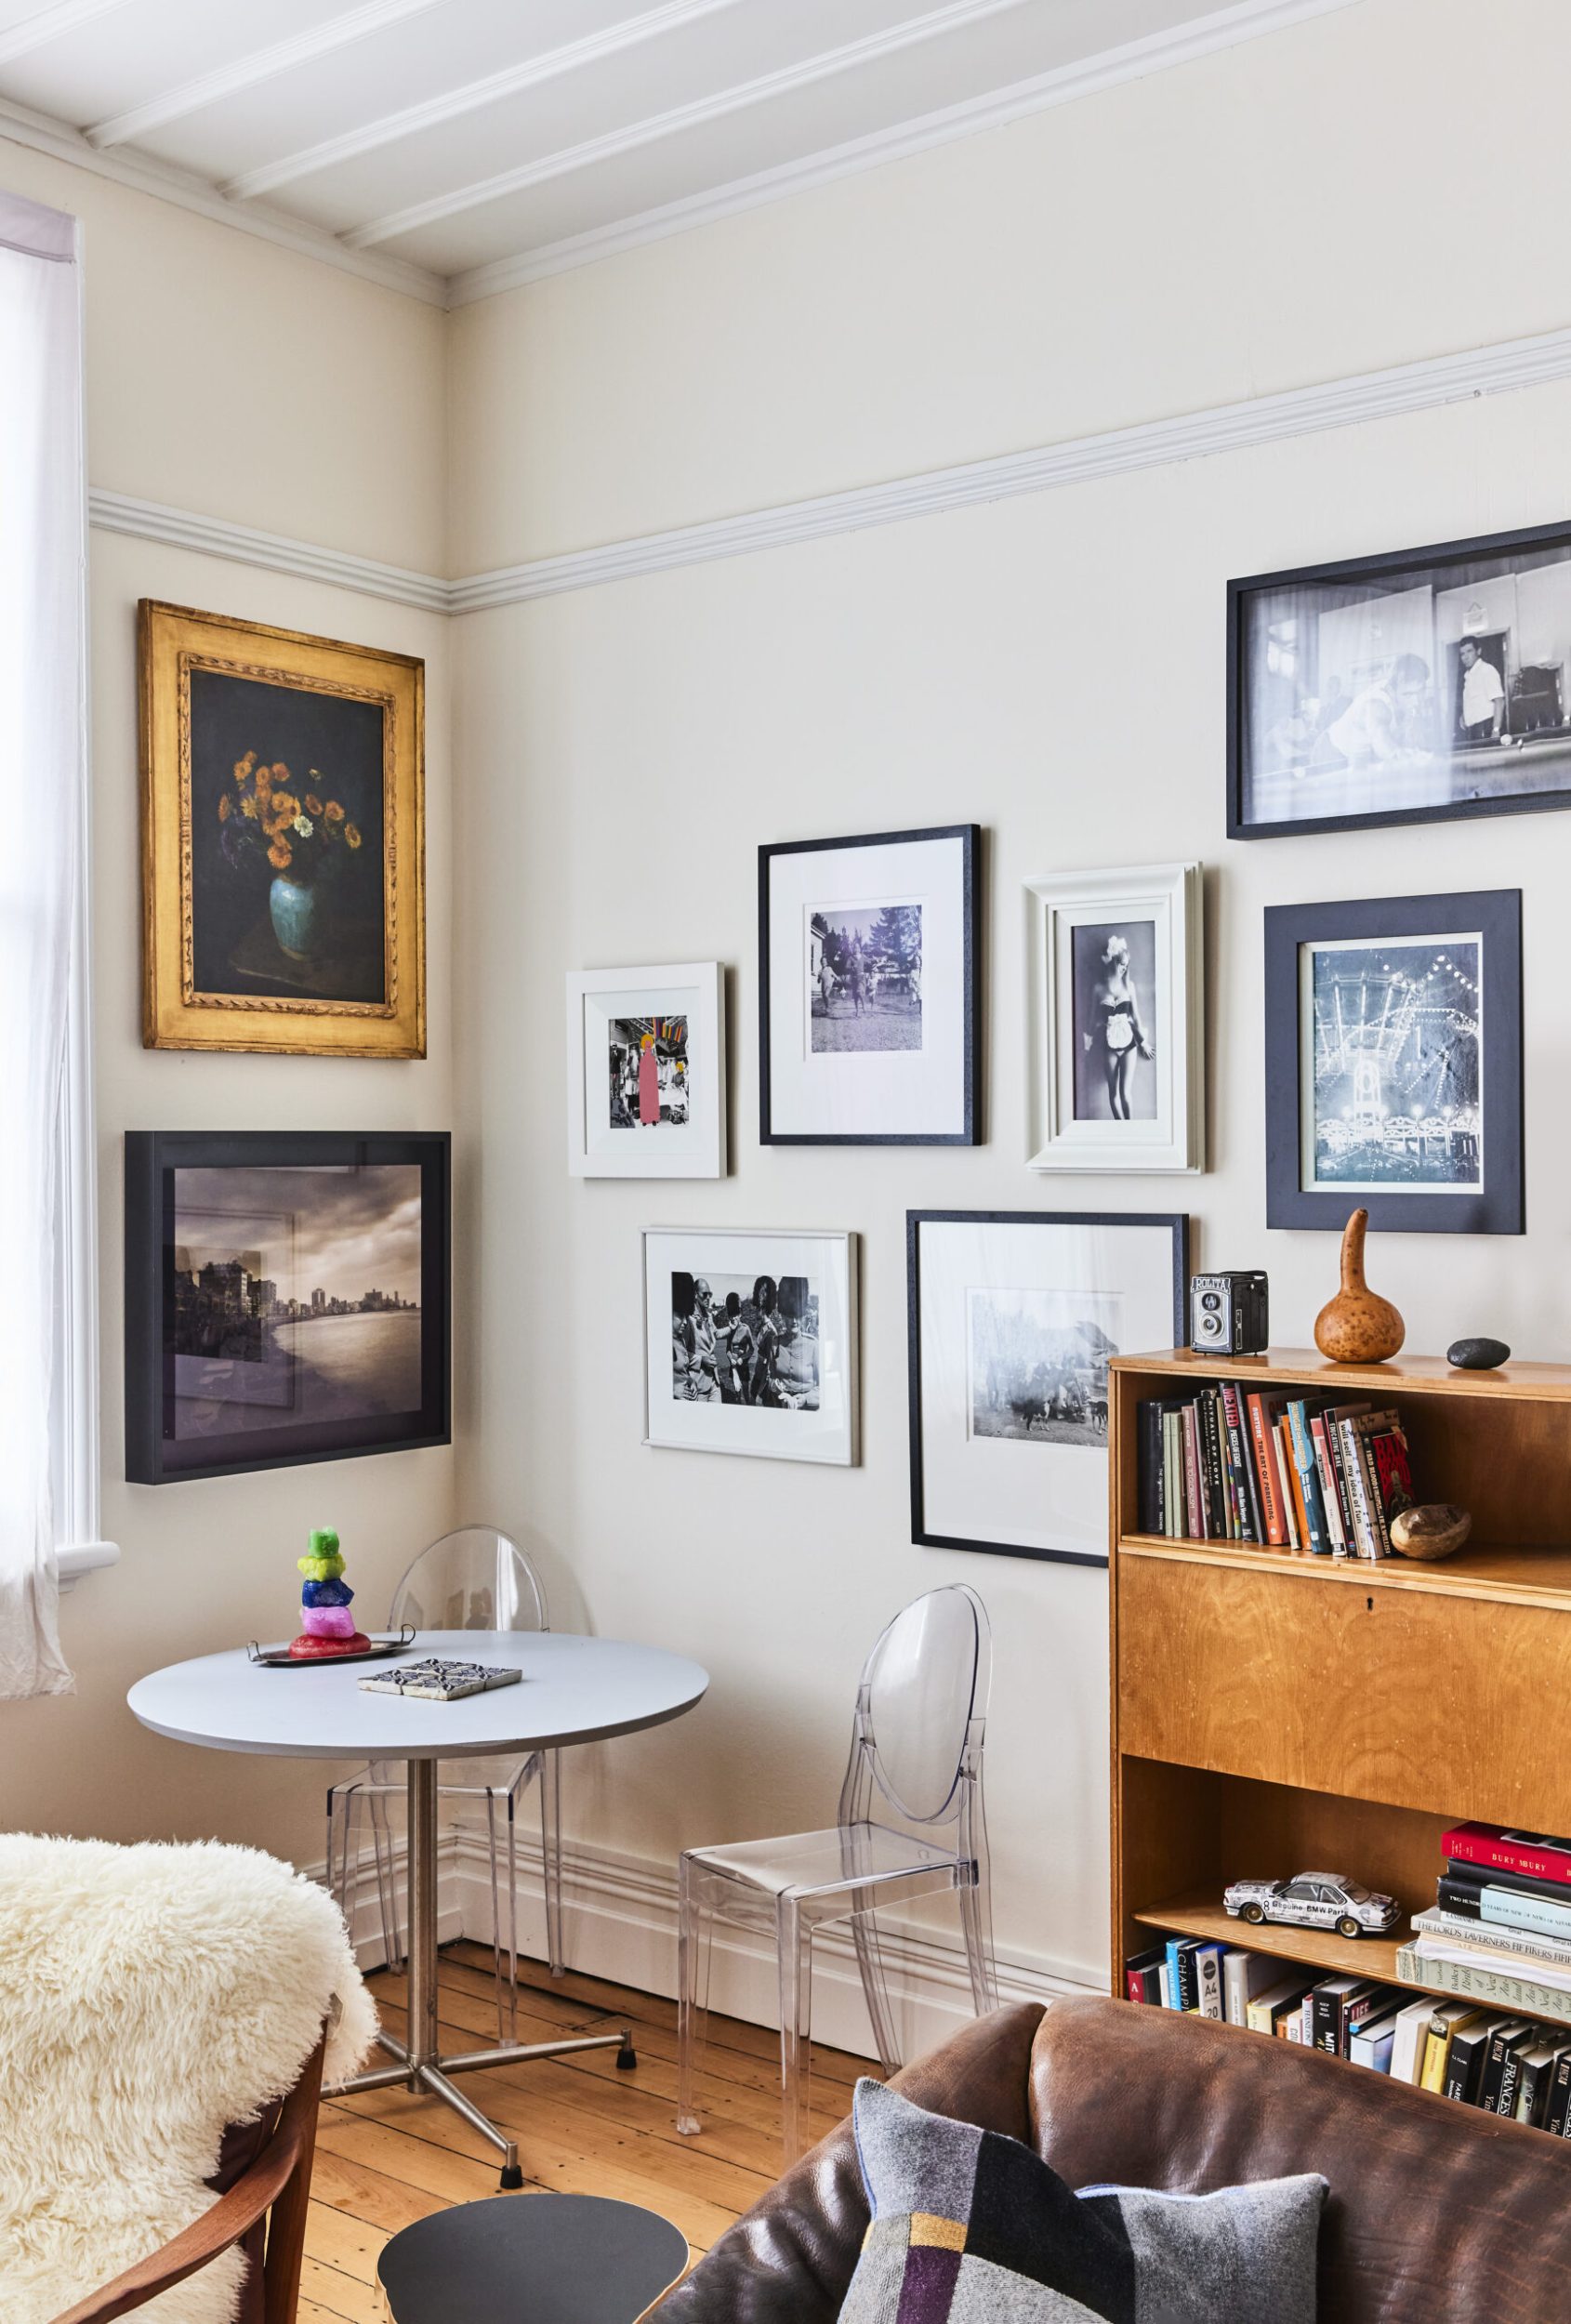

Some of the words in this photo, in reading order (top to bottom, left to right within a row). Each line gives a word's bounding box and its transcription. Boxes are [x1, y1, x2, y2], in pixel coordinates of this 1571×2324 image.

[1195, 1278, 1227, 1291] ROLITA
[1222, 1387, 1239, 1427] MEXTED
[1252, 1406, 1262, 1439] NURTURE
[1329, 1422, 1340, 1452] EDUCATING
[1340, 1423, 1350, 1439] will
[1211, 1445, 1217, 1454] OF
[1343, 1440, 1352, 1457] self
[1261, 1471, 1269, 1483] OF
[1347, 1465, 1354, 1477] my
[1349, 1479, 1358, 1498] idea
[1263, 1484, 1274, 1520] PARENTING
[1353, 1499, 1360, 1508] of
[1354, 1509, 1363, 1525] fun
[1272, 1900, 1303, 1912] Genuine
[1306, 1905, 1327, 1914] BMW
[1449, 1895, 1461, 1903] TWO
[1418, 1921, 1435, 1933] THE
[1464, 1930, 1511, 1949] TAVERNERS
[1205, 1982, 1217, 1998] A4
[1207, 2006, 1219, 2019] 20
[1499, 2061, 1517, 2116] FRANCES
[1485, 2095, 1495, 2110] Yin
[1550, 2119, 1561, 2133] Yin
